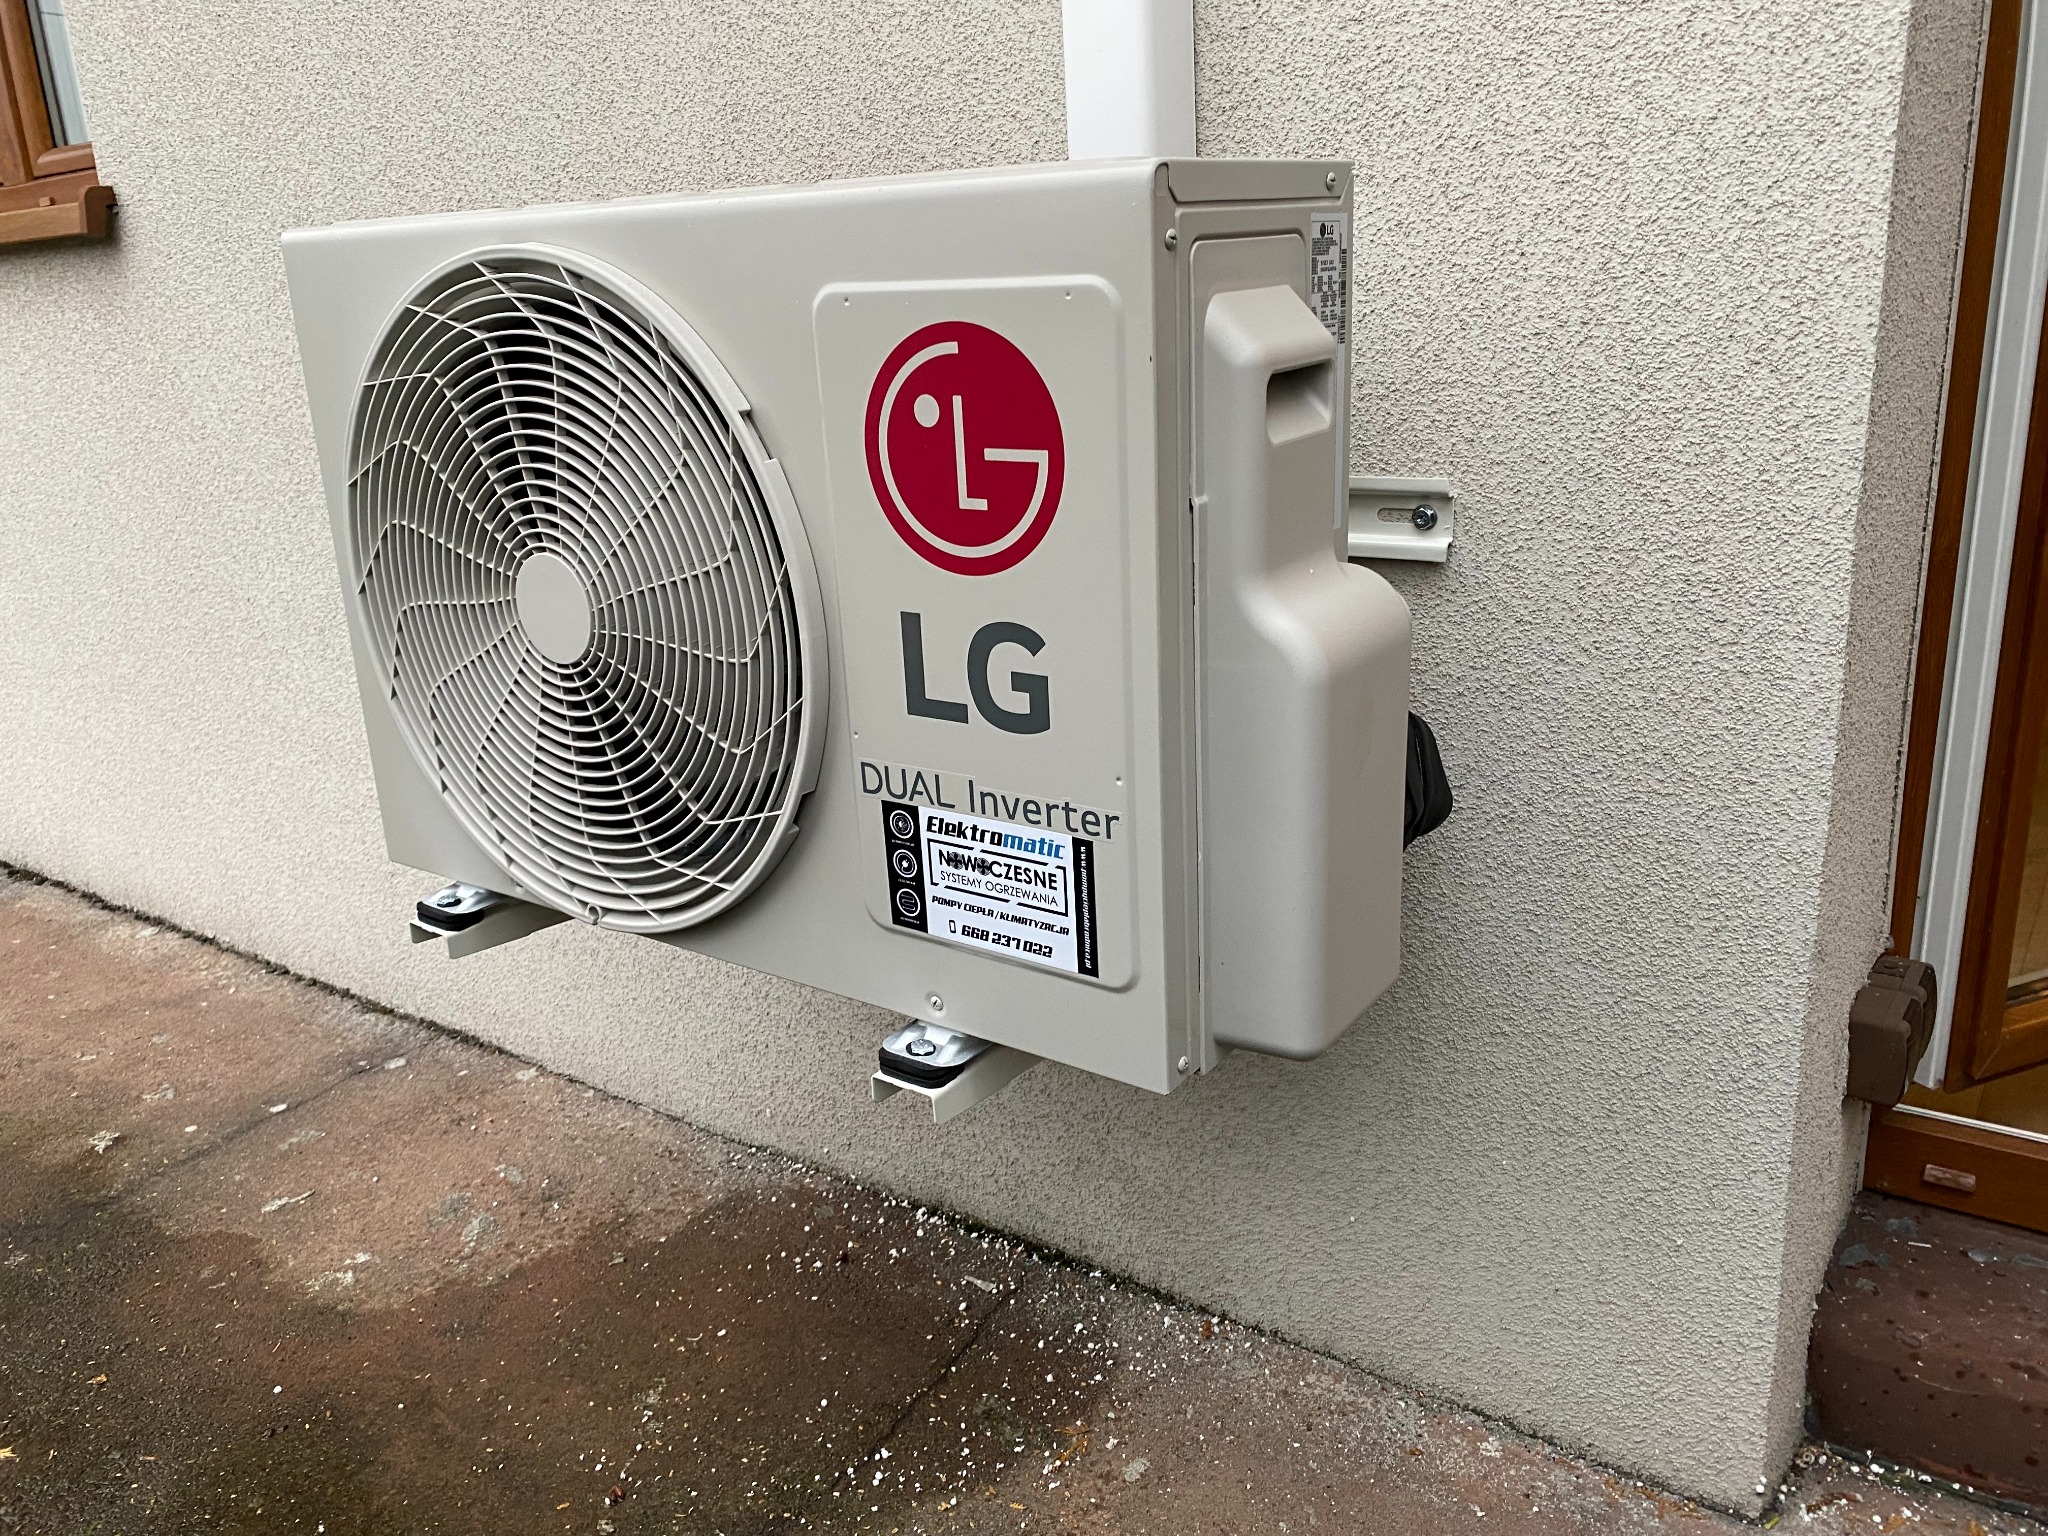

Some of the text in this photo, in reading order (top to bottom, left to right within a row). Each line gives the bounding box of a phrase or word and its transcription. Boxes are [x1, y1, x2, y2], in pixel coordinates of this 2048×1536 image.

[1326, 225, 1334, 236] LG
[899, 610, 1051, 735] LG
[860, 762, 1120, 839] DUAL Inverter
[926, 815, 1066, 860] Elektromatic
[938, 848, 1058, 891] NOWOCZESNE
[940, 870, 1059, 907] SYSTEMY OGRZEWANIA
[931, 895, 963, 910] POMPY
[963, 903, 995, 918] CIEPŁA
[961, 924, 1054, 959] 668 237 022
